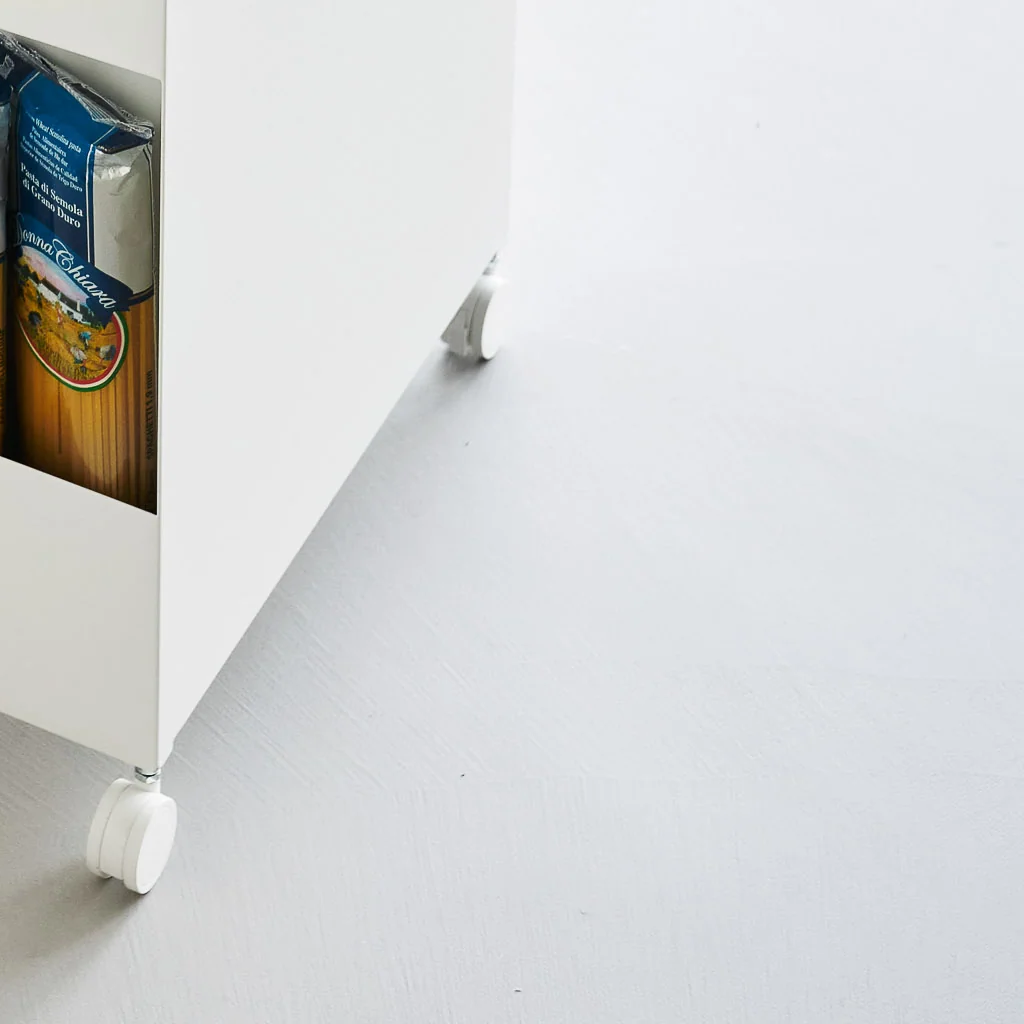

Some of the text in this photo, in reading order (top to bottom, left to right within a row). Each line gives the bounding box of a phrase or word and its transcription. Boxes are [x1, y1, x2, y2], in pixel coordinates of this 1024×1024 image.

[35, 118, 49, 134] Wheat
[68, 140, 82, 154] pasta
[20, 161, 84, 217] Pasta di Semola
[58, 173, 70, 188] Trigo
[69, 181, 83, 193] Duro
[60, 166, 78, 183] Calidad
[22, 179, 81, 229] di Grano Duro
[52, 238, 117, 309] Chiara
[146, 369, 153, 389] mm
